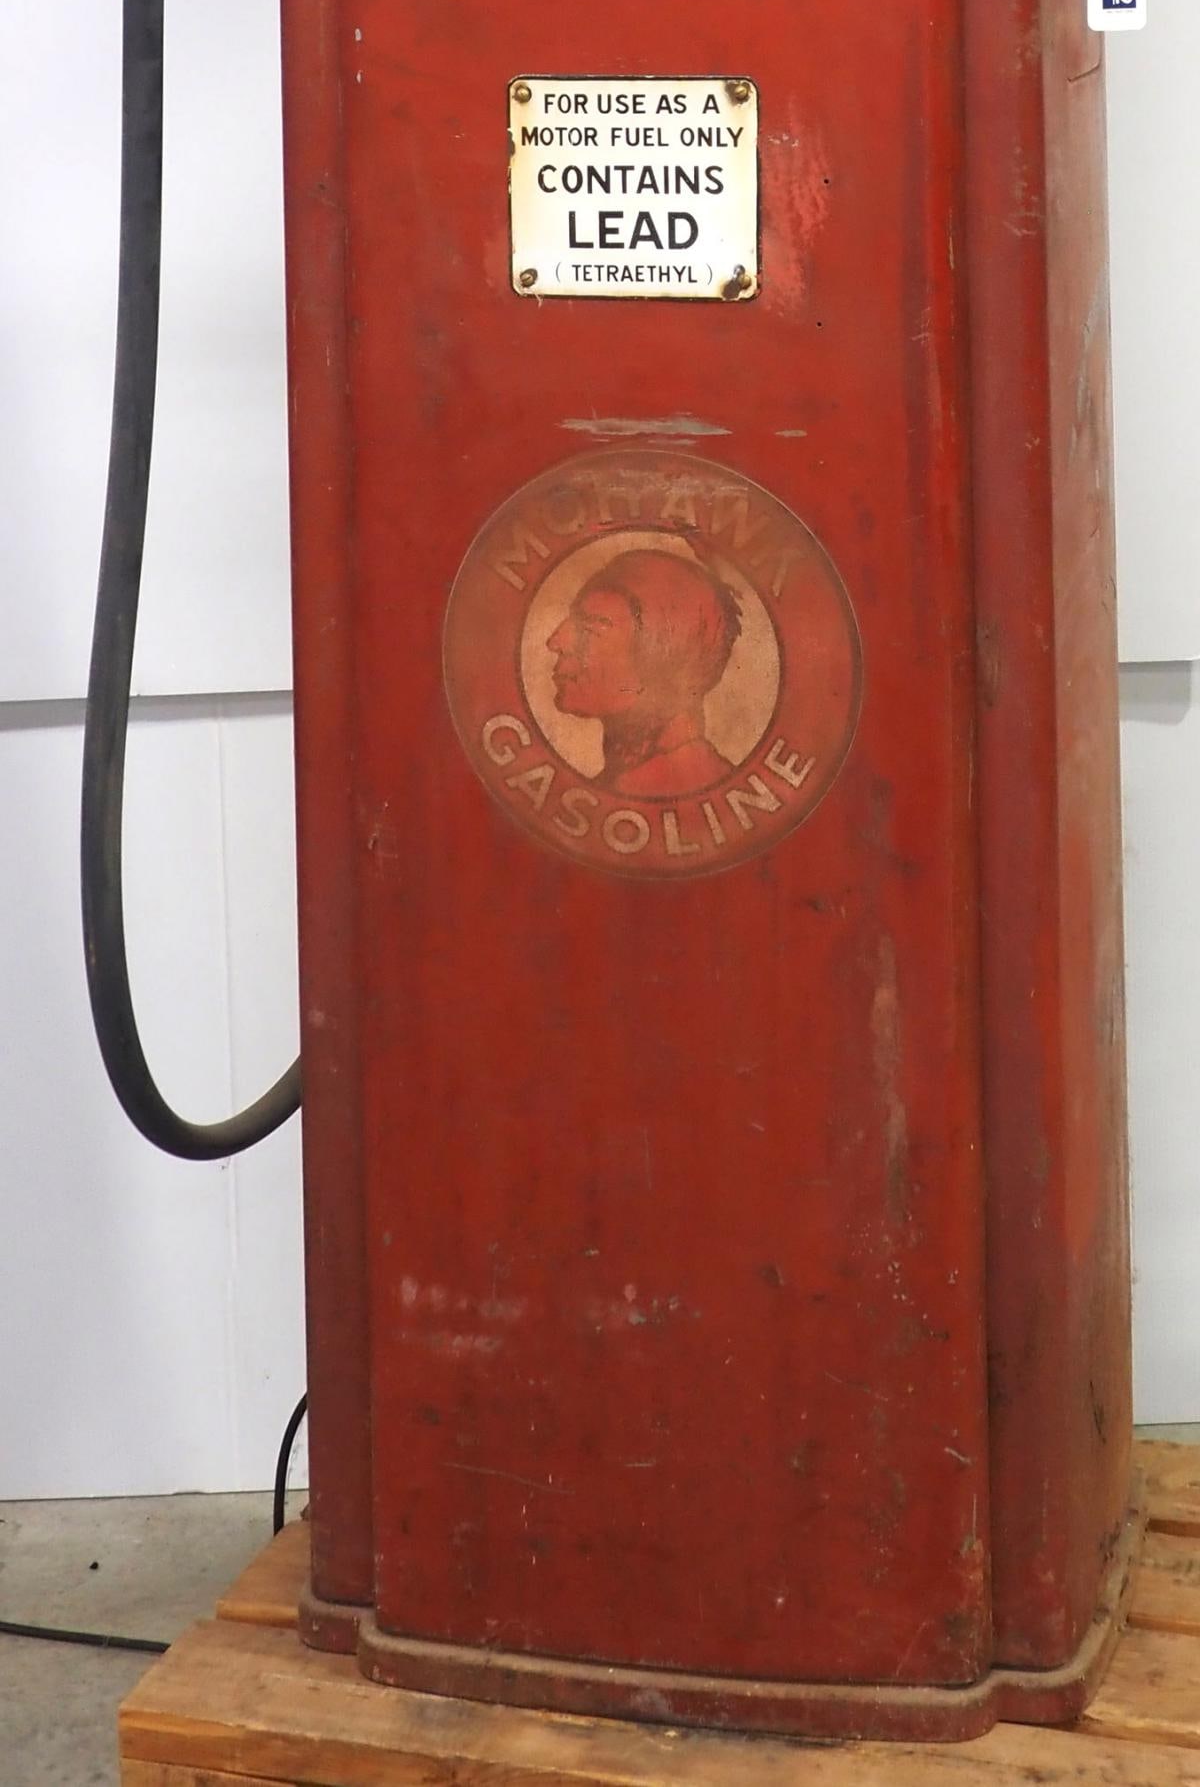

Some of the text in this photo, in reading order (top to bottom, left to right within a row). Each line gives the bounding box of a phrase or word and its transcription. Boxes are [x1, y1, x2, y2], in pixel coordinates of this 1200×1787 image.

[543, 94, 720, 114] FOR USE AS A
[521, 127, 744, 147] MOTOR FUEL ONLY
[537, 164, 724, 195] CONTAINS
[568, 210, 699, 250] LEAD
[481, 713, 817, 856] GASOLINE
